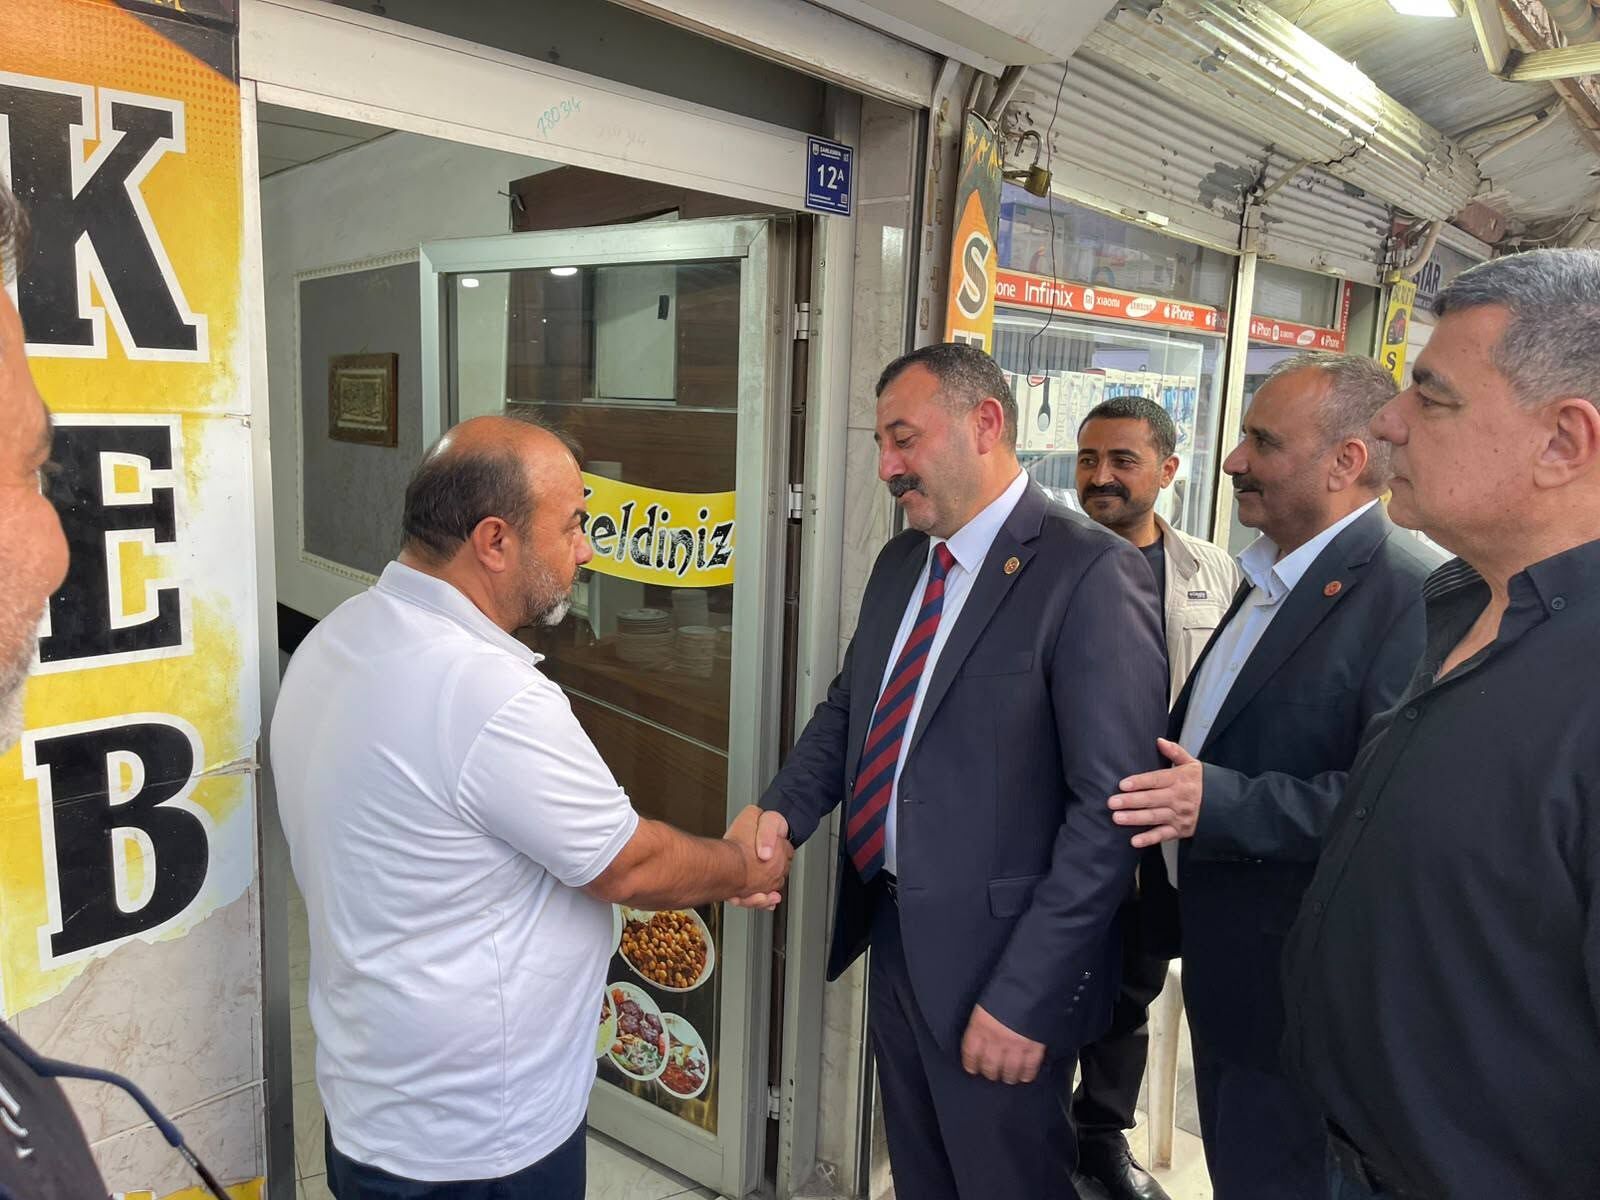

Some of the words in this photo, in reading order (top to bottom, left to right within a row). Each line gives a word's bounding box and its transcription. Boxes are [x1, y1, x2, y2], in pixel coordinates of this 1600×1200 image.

[817, 163, 845, 190] 12A
[993, 281, 1016, 298] one
[1025, 280, 1074, 308] Infinix
[1171, 303, 1195, 321] iPhone
[581, 486, 735, 577] eldiniz
